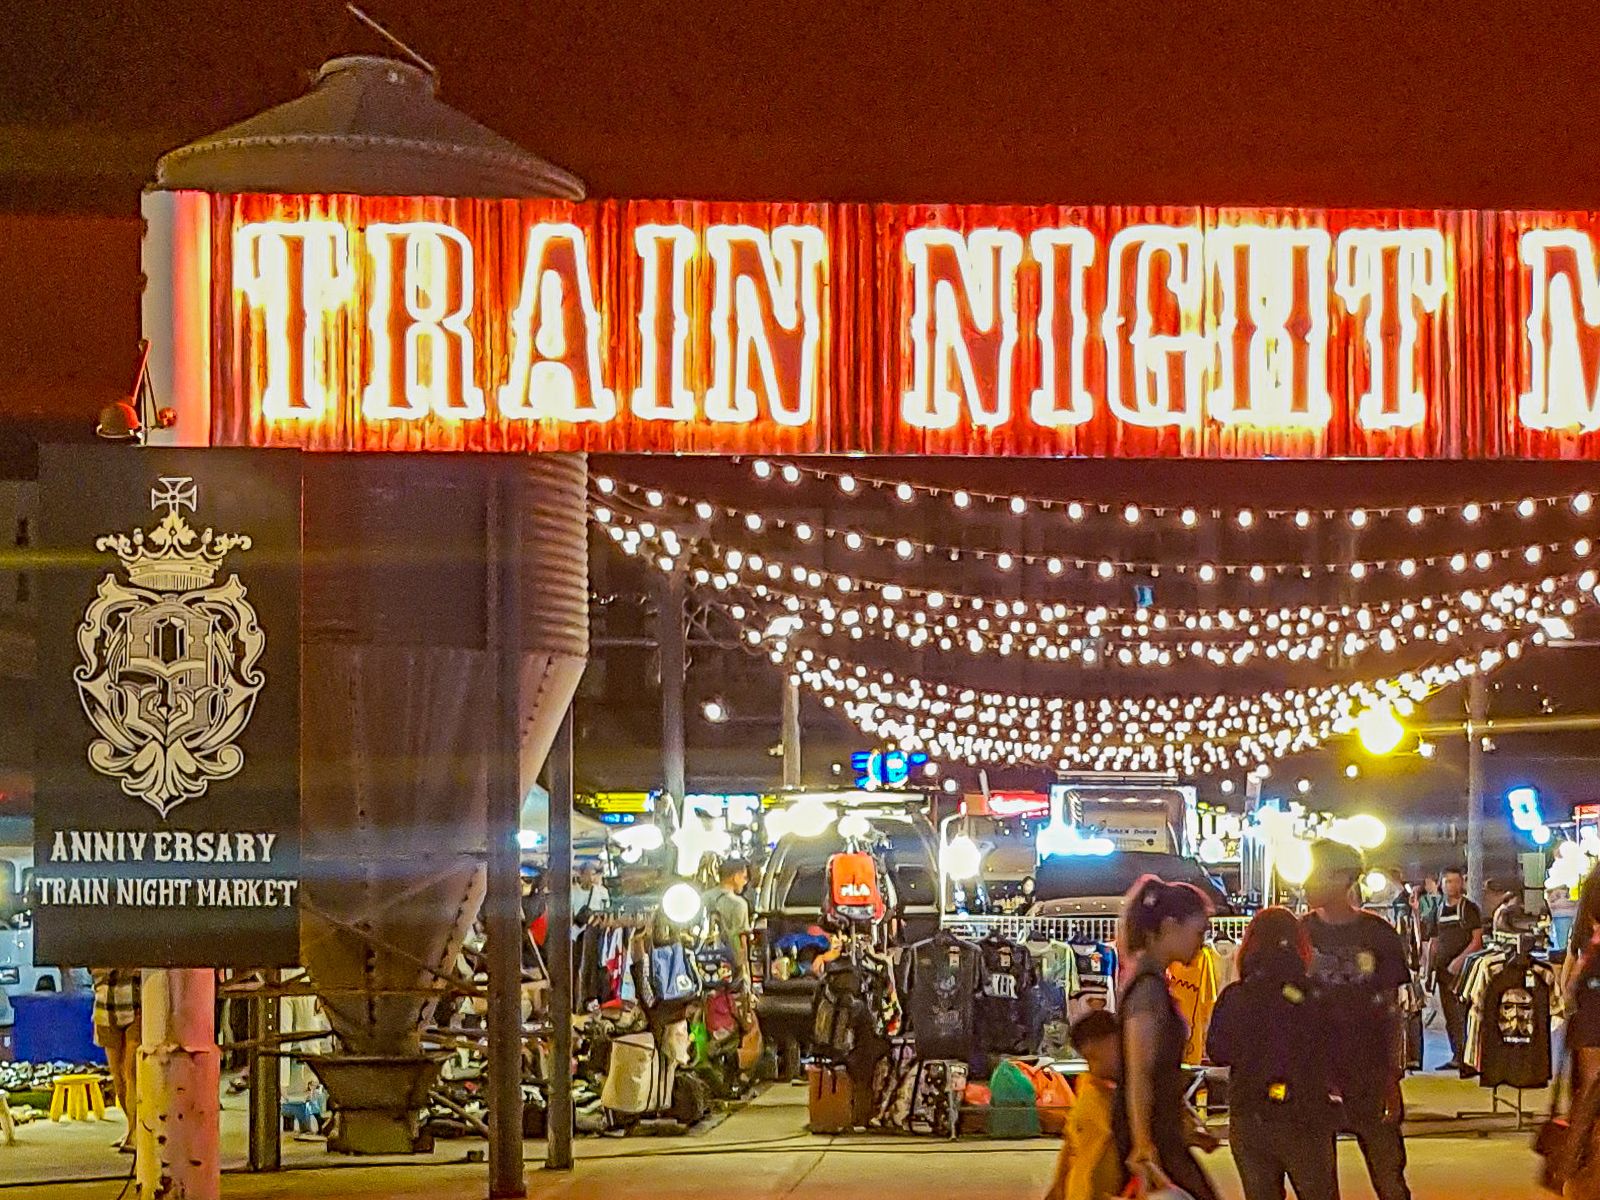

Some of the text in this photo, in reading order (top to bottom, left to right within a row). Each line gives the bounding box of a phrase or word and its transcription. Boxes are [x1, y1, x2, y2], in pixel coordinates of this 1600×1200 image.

[232, 220, 828, 426] TRAIN
[902, 225, 1451, 431] NIGHT
[50, 830, 276, 863] ANNIVERSARY
[35, 877, 298, 908] TRAIN NIGHT MARKET
